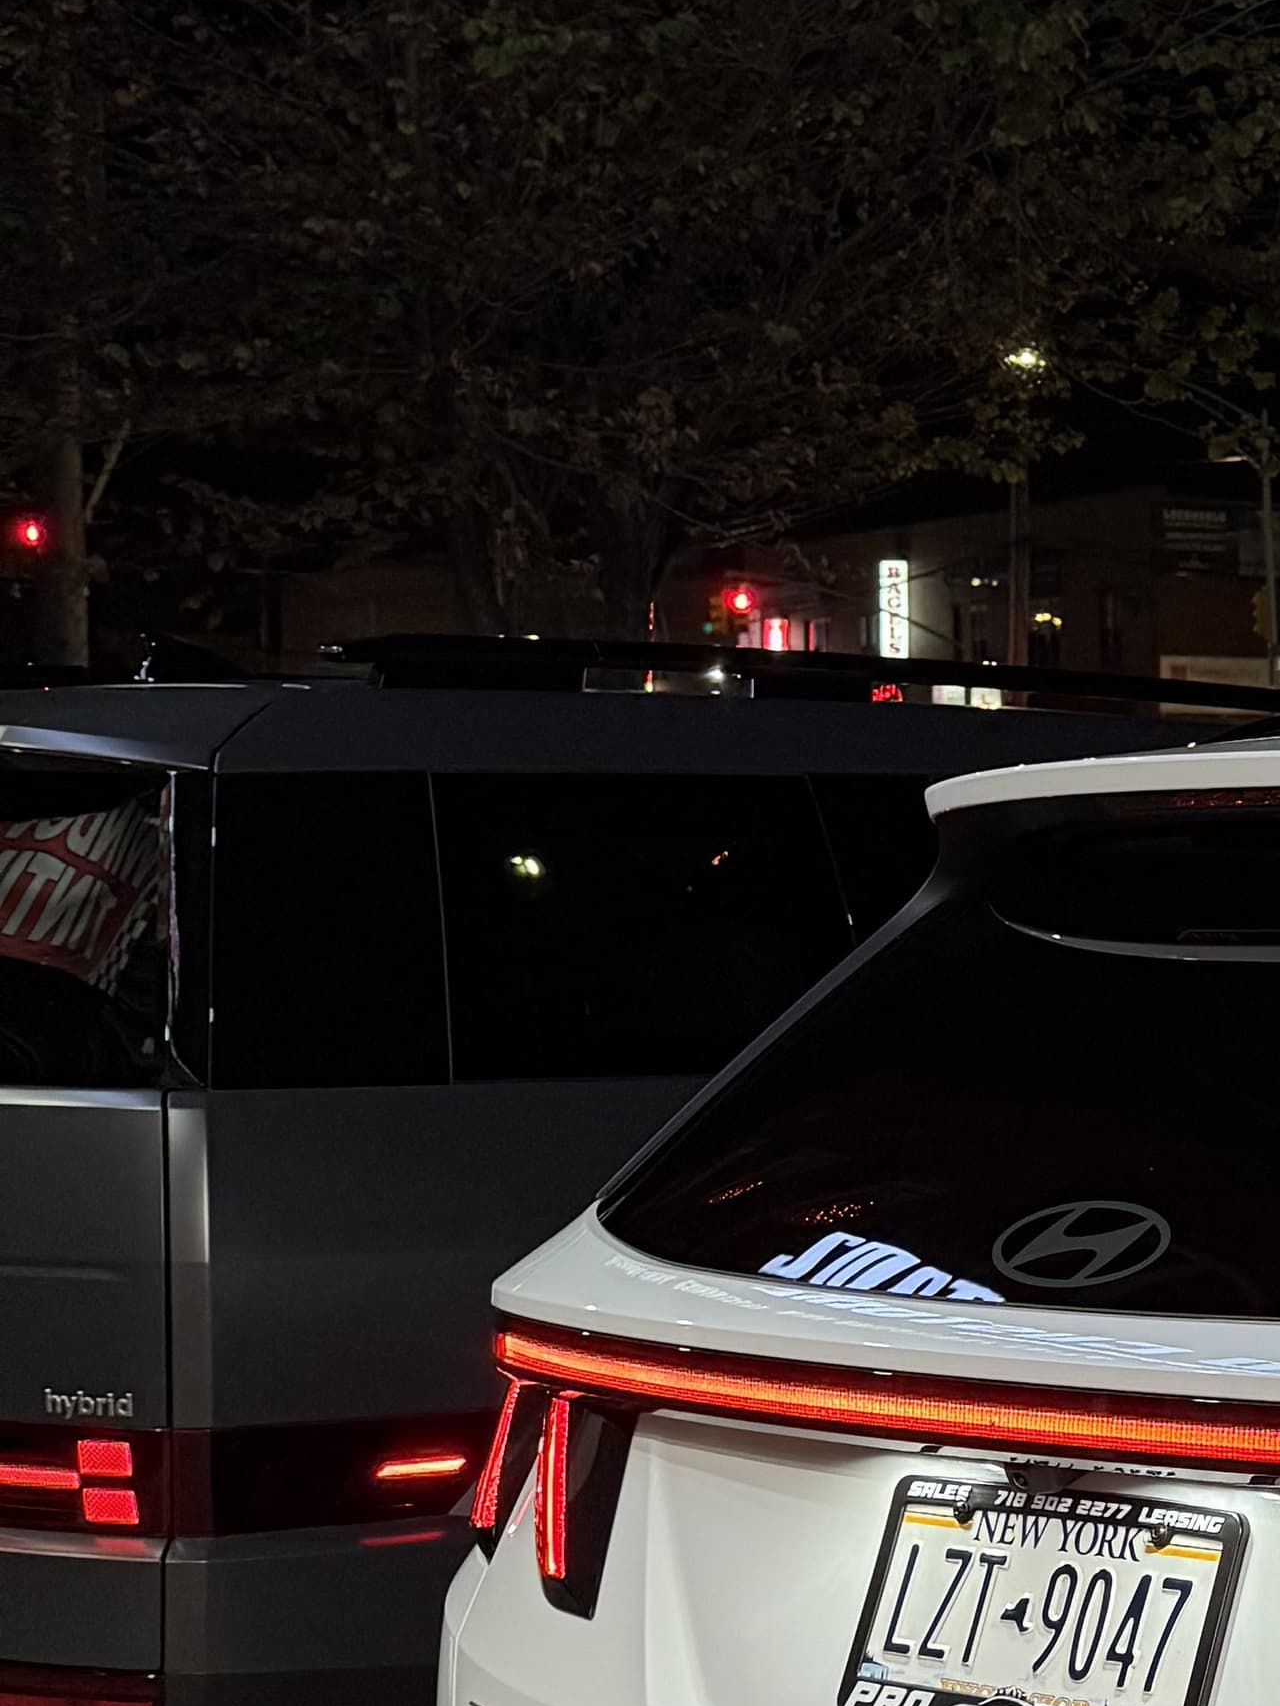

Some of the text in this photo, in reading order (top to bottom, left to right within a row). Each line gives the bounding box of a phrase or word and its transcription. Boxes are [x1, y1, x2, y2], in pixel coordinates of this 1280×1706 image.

[44, 1388, 133, 1420] hybrid
[907, 1480, 1226, 1534] SALES 718 902 2277 LEASING
[972, 1510, 1142, 1563] NEW YORK
[883, 1543, 1194, 1694] LZT 9047
